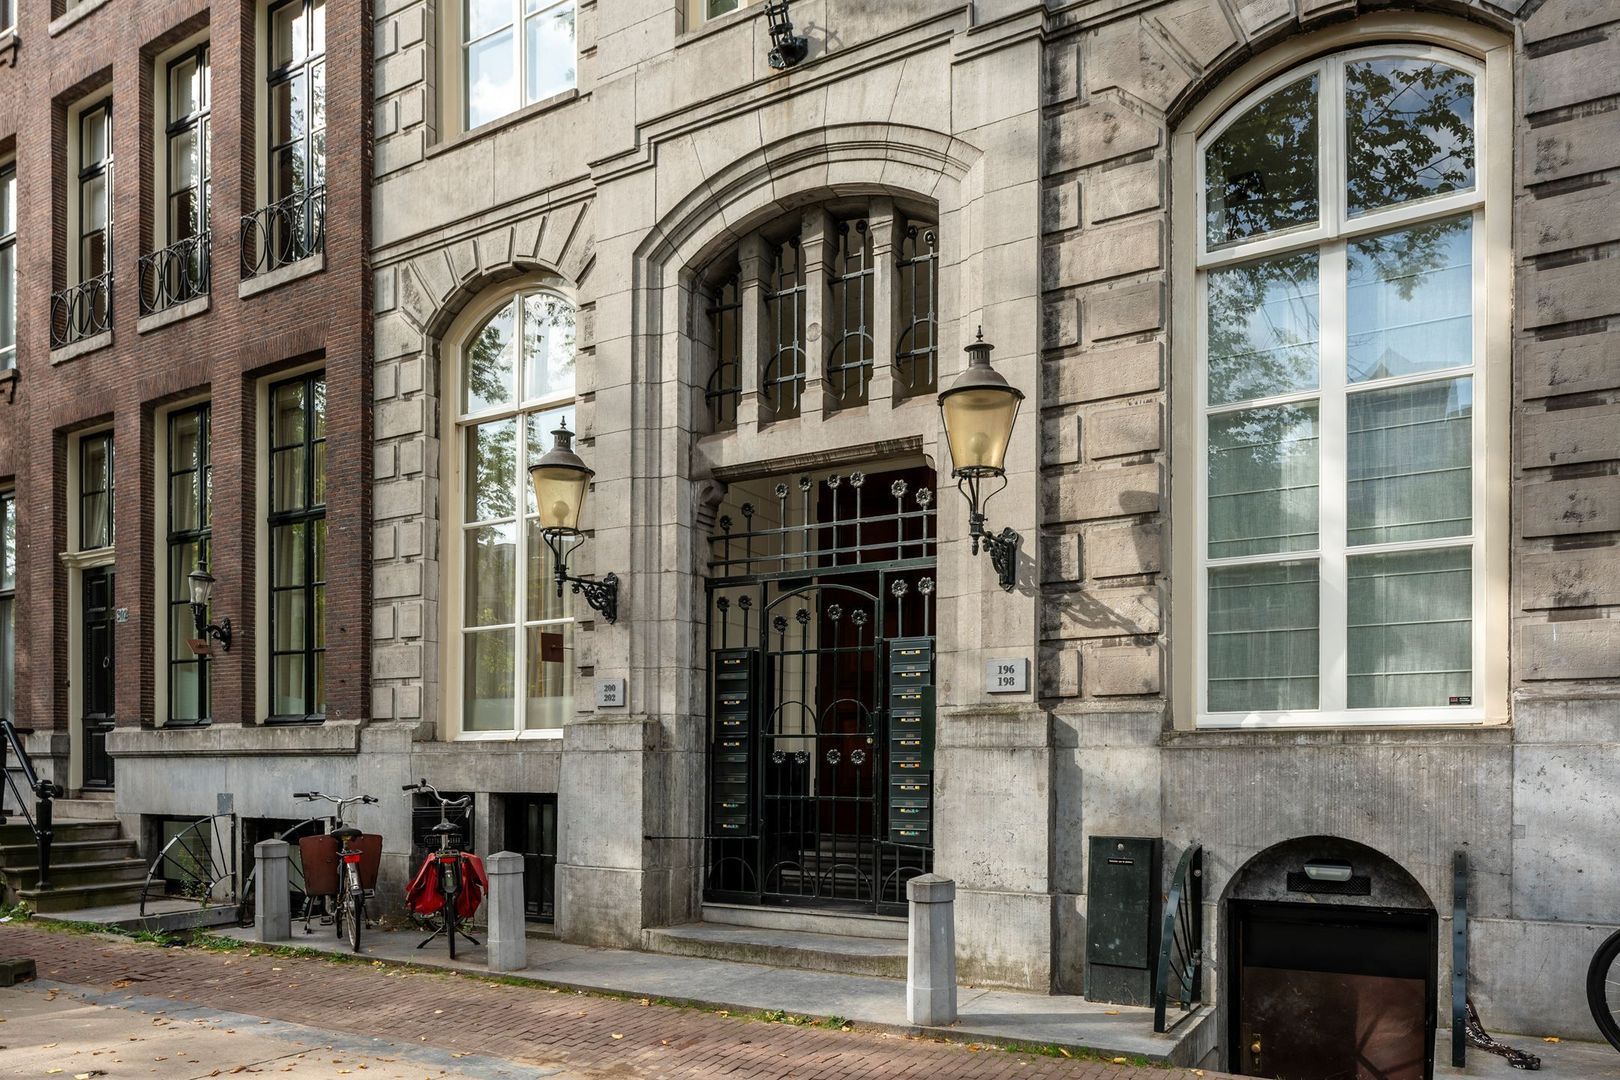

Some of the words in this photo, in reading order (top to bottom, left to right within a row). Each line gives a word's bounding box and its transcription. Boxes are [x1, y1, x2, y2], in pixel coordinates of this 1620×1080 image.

[998, 665, 1015, 674] 196
[998, 677, 1015, 686] 198
[604, 684, 616, 692] 200
